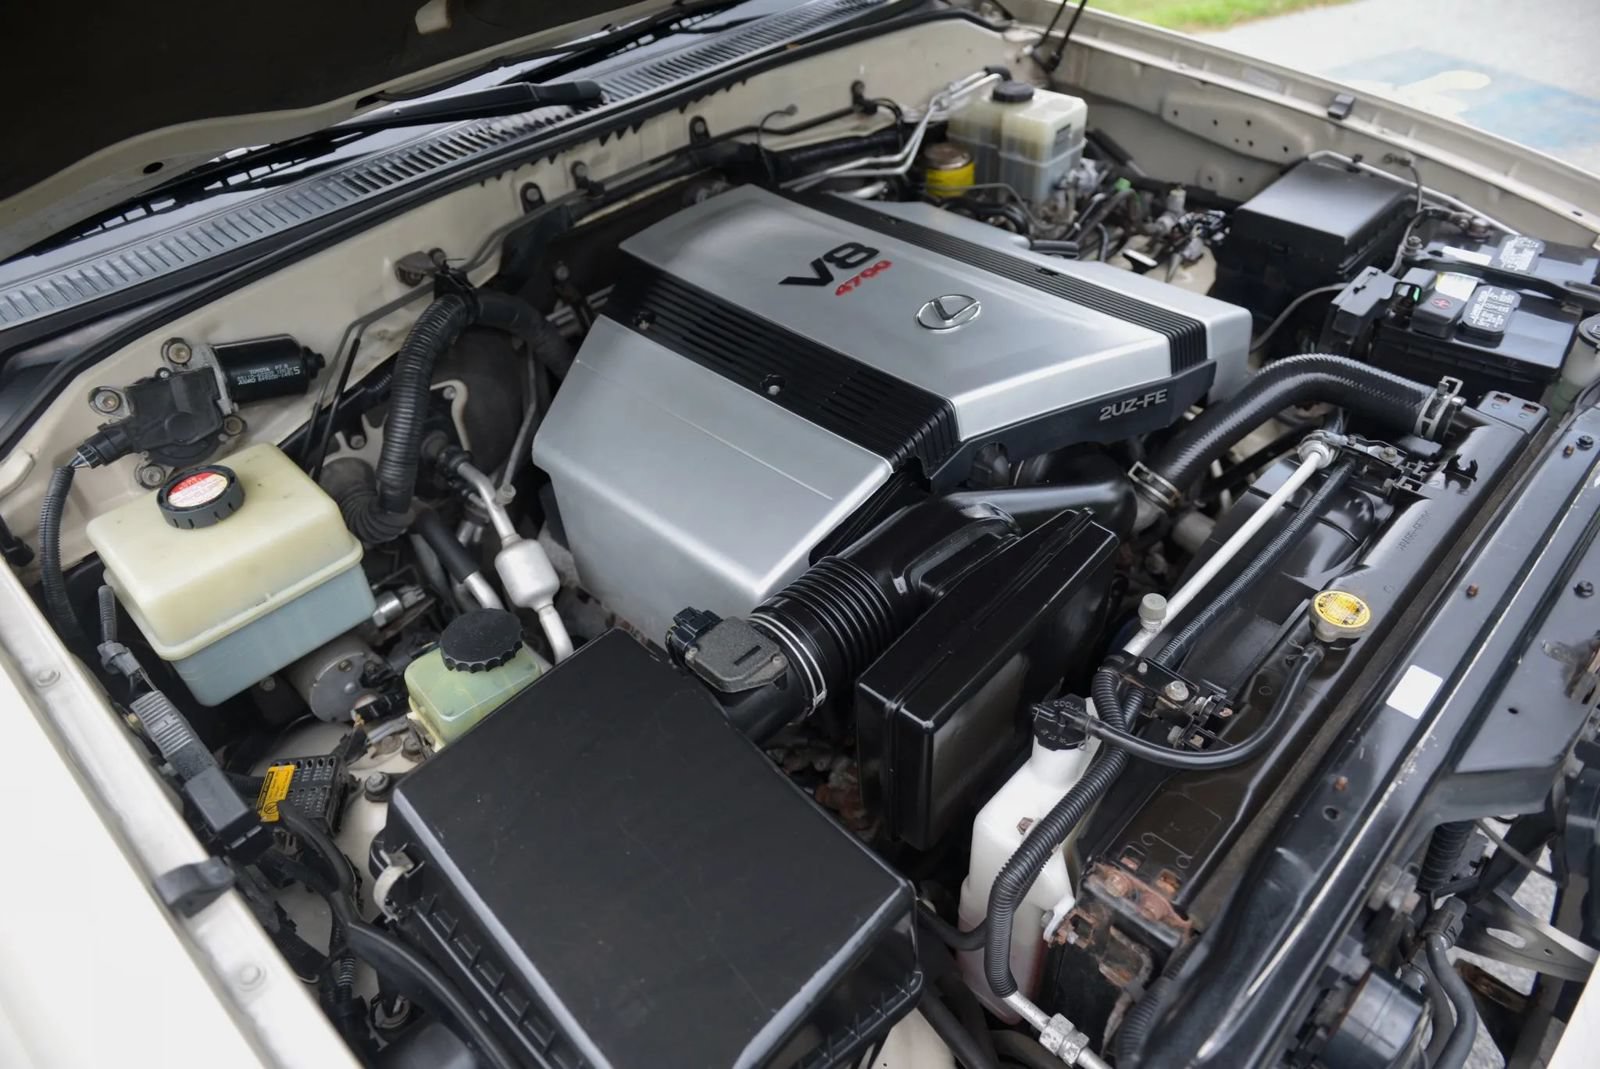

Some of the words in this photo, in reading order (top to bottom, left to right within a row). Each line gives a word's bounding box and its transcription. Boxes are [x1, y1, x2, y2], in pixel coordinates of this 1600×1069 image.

[778, 241, 880, 287] V8
[835, 259, 892, 297] 4700
[1099, 388, 1168, 421] 2UZ-FE
